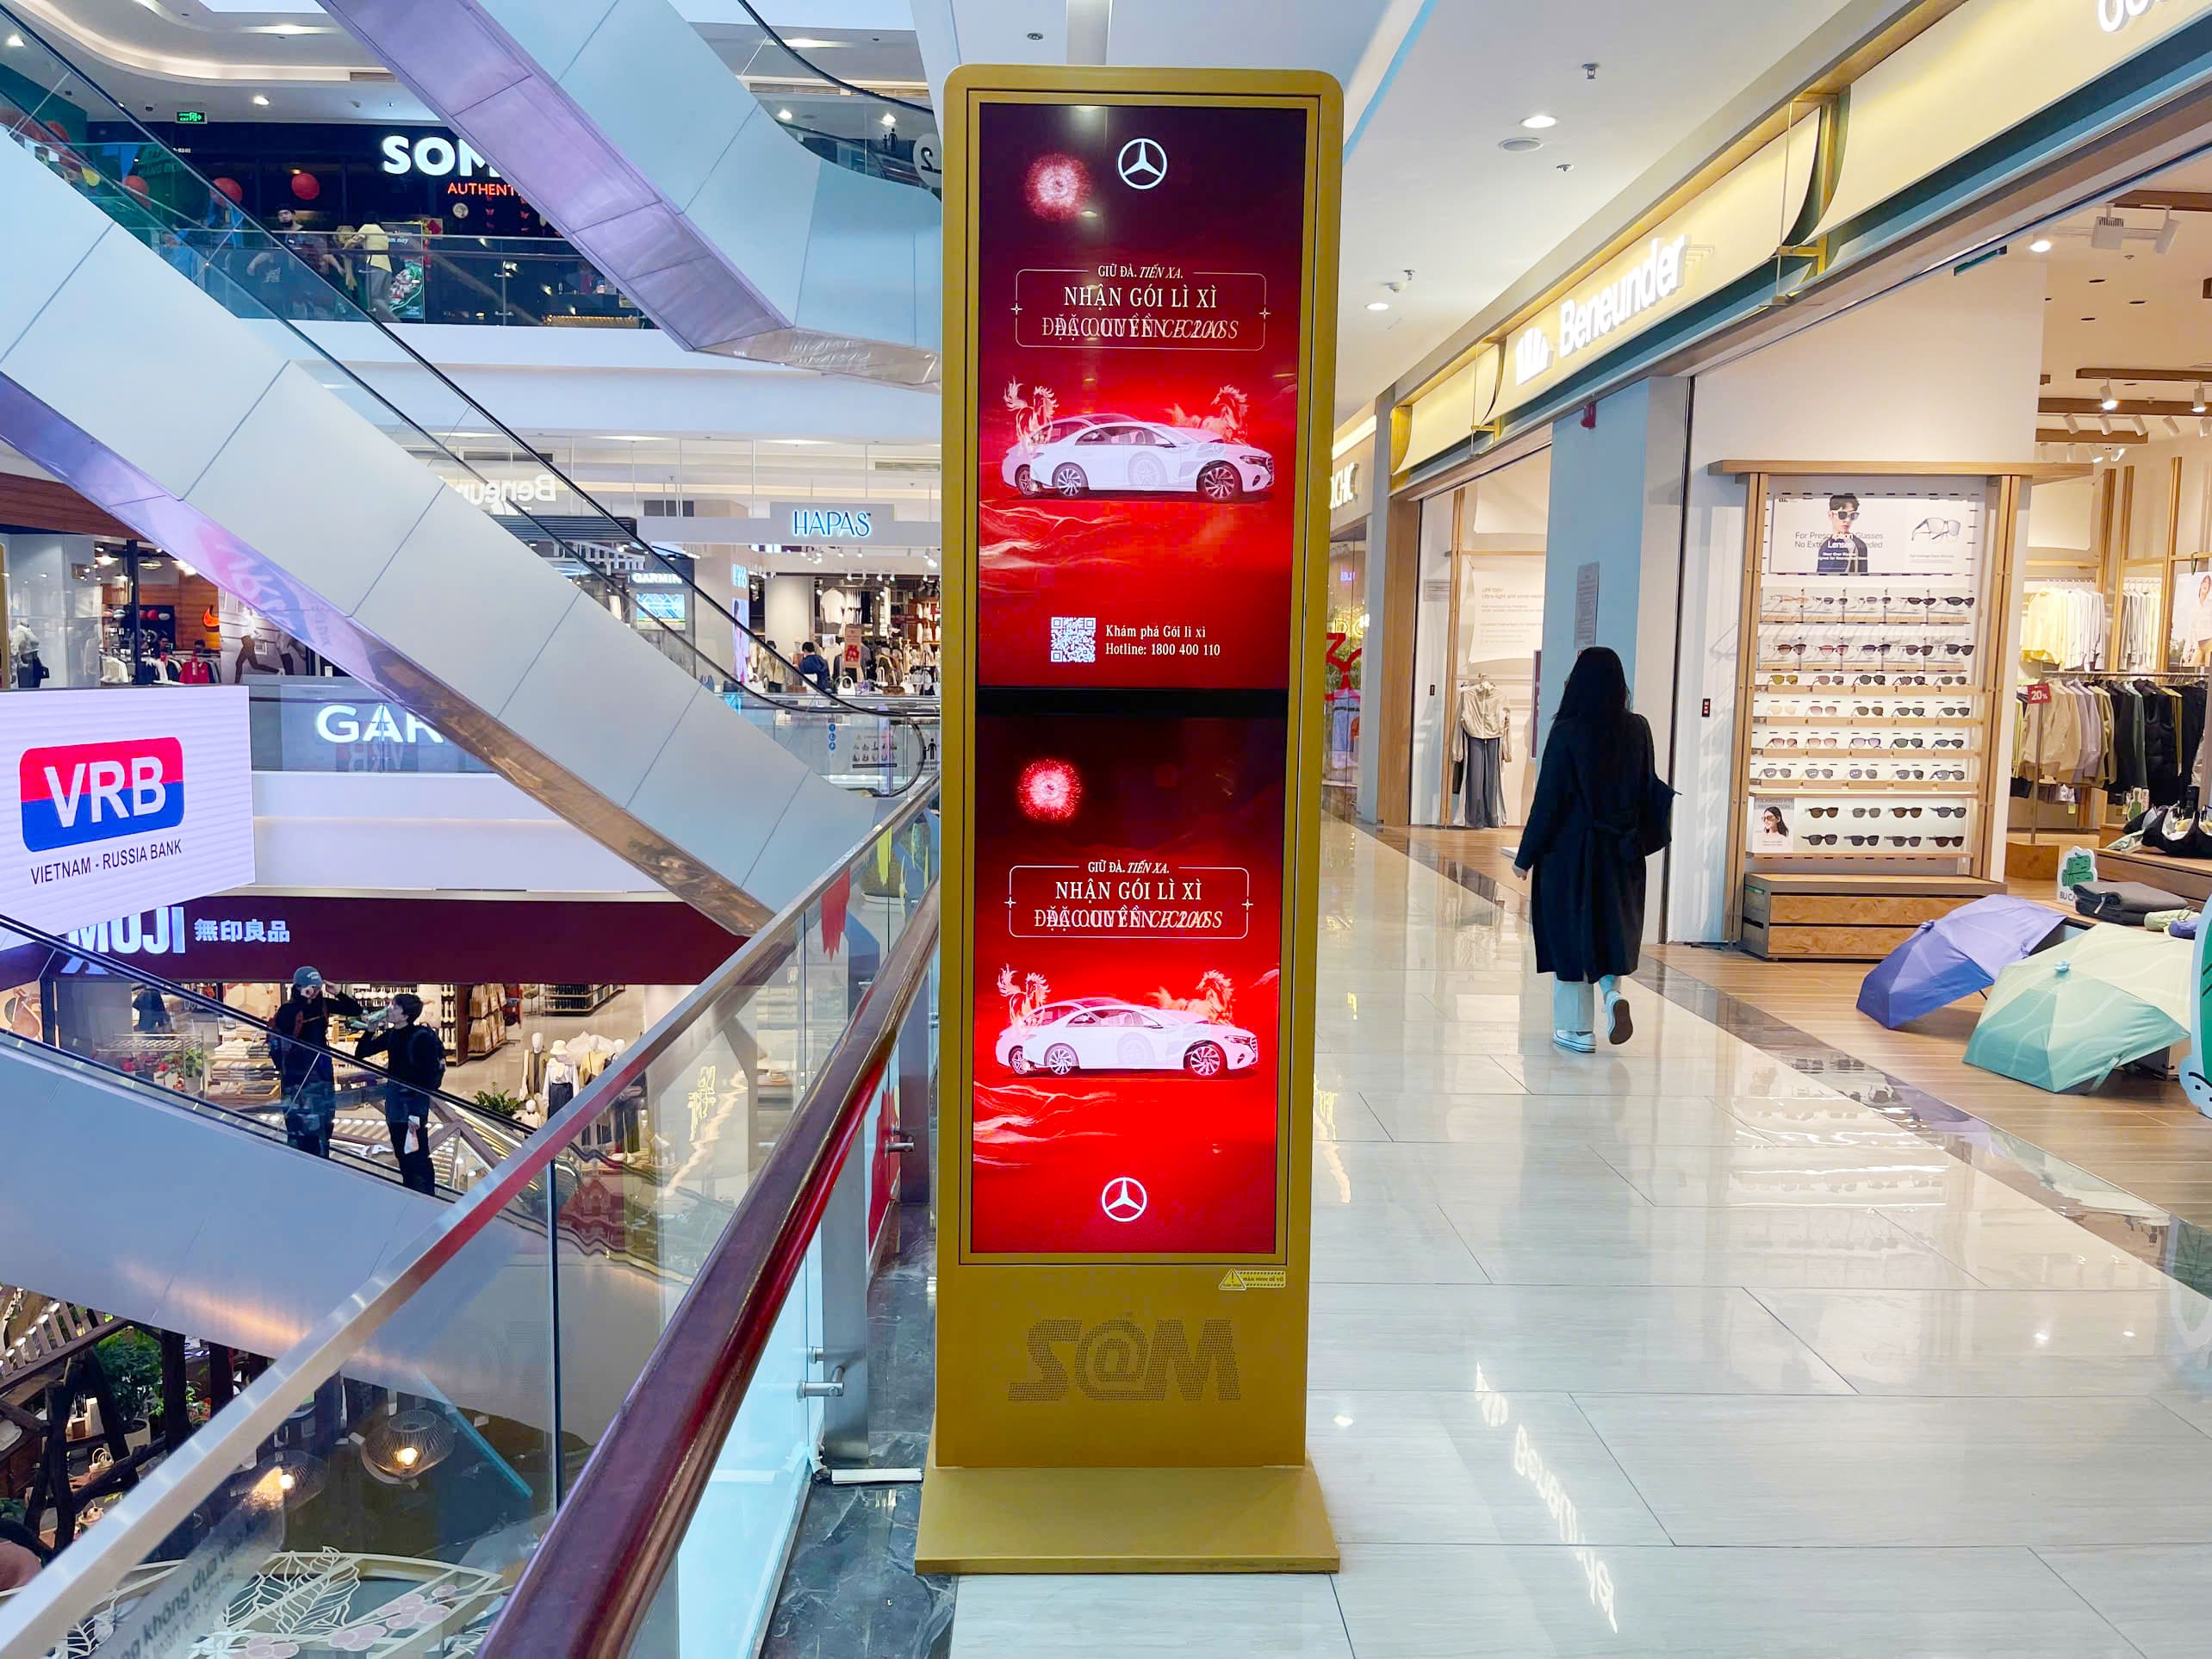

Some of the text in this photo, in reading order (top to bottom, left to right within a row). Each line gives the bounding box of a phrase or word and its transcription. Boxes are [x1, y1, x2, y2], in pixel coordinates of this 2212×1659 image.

[447, 182, 521, 196] AUTHENT
[1064, 284, 1217, 311] NHẬN GÓI LÌ XÌ
[1558, 234, 1690, 358] Beneunder
[792, 509, 870, 537] HAPAS
[1105, 624, 1137, 637] Khám
[1140, 624, 1159, 640] phá
[1163, 624, 1181, 637] Gói
[1105, 643, 1221, 656] Hotline: 1800 400 110
[43, 755, 167, 829] VRB
[30, 856, 92, 885] VIETNAM
[103, 846, 148, 872] RUSSIA
[150, 837, 183, 861] BANK
[1055, 878, 1202, 904] NHẬN GÓI LÌ XÌ
[193, 918, 291, 942] 無印良品
